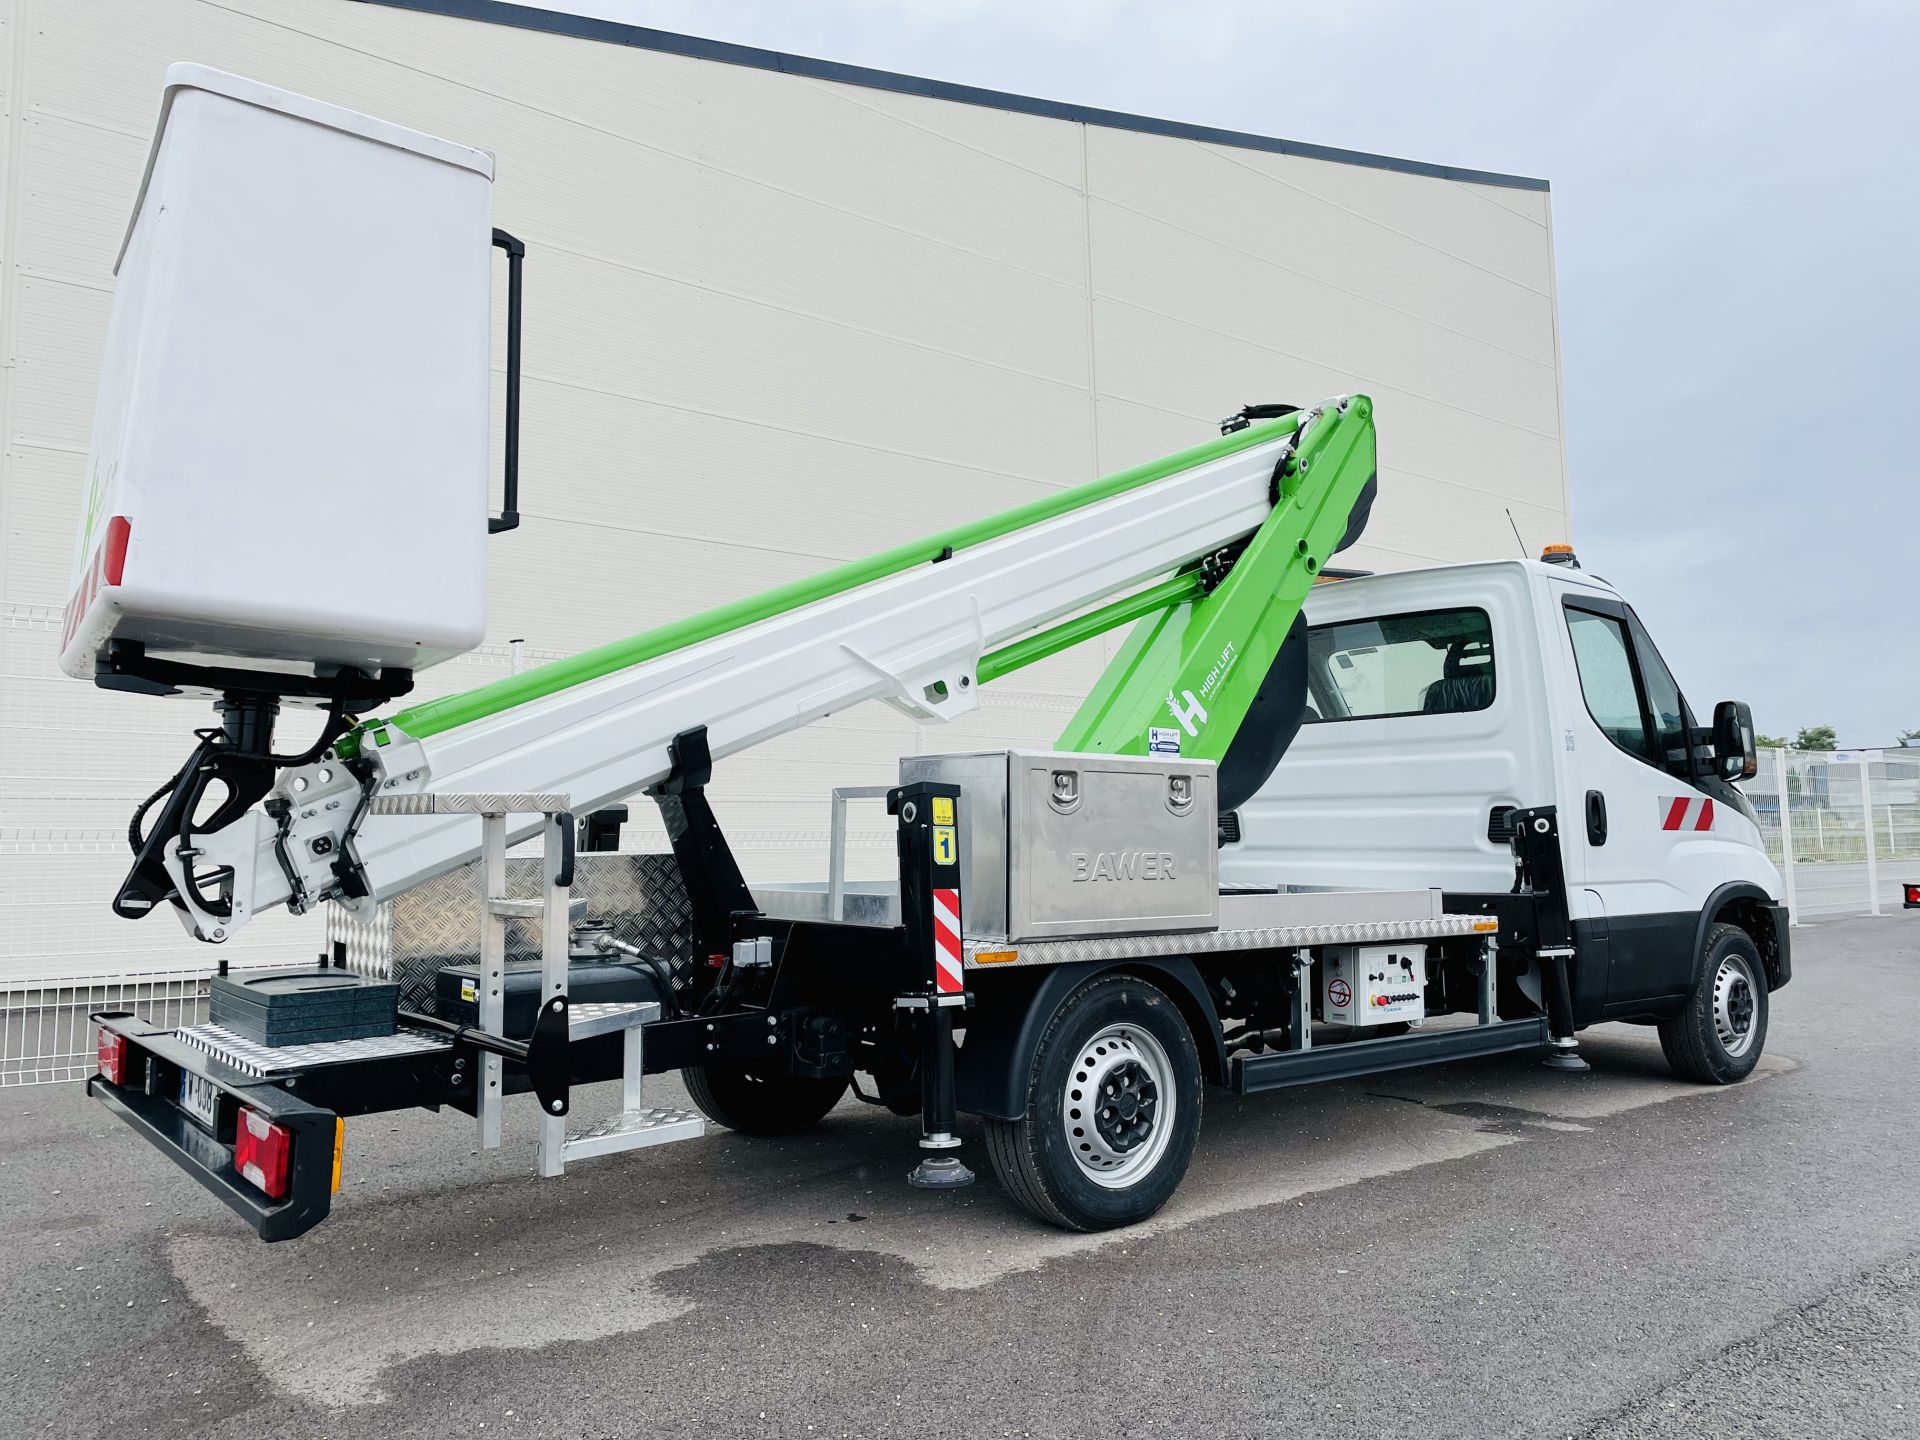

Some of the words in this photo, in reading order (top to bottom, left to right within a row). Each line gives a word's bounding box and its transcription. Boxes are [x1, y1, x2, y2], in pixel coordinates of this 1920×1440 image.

[1199, 665, 1220, 698] HIGH
[1217, 640, 1235, 669] LIFT
[1166, 689, 1208, 737] H
[1152, 729, 1157, 740] H
[941, 837, 949, 858] 1
[1071, 852, 1177, 882] BAWER
